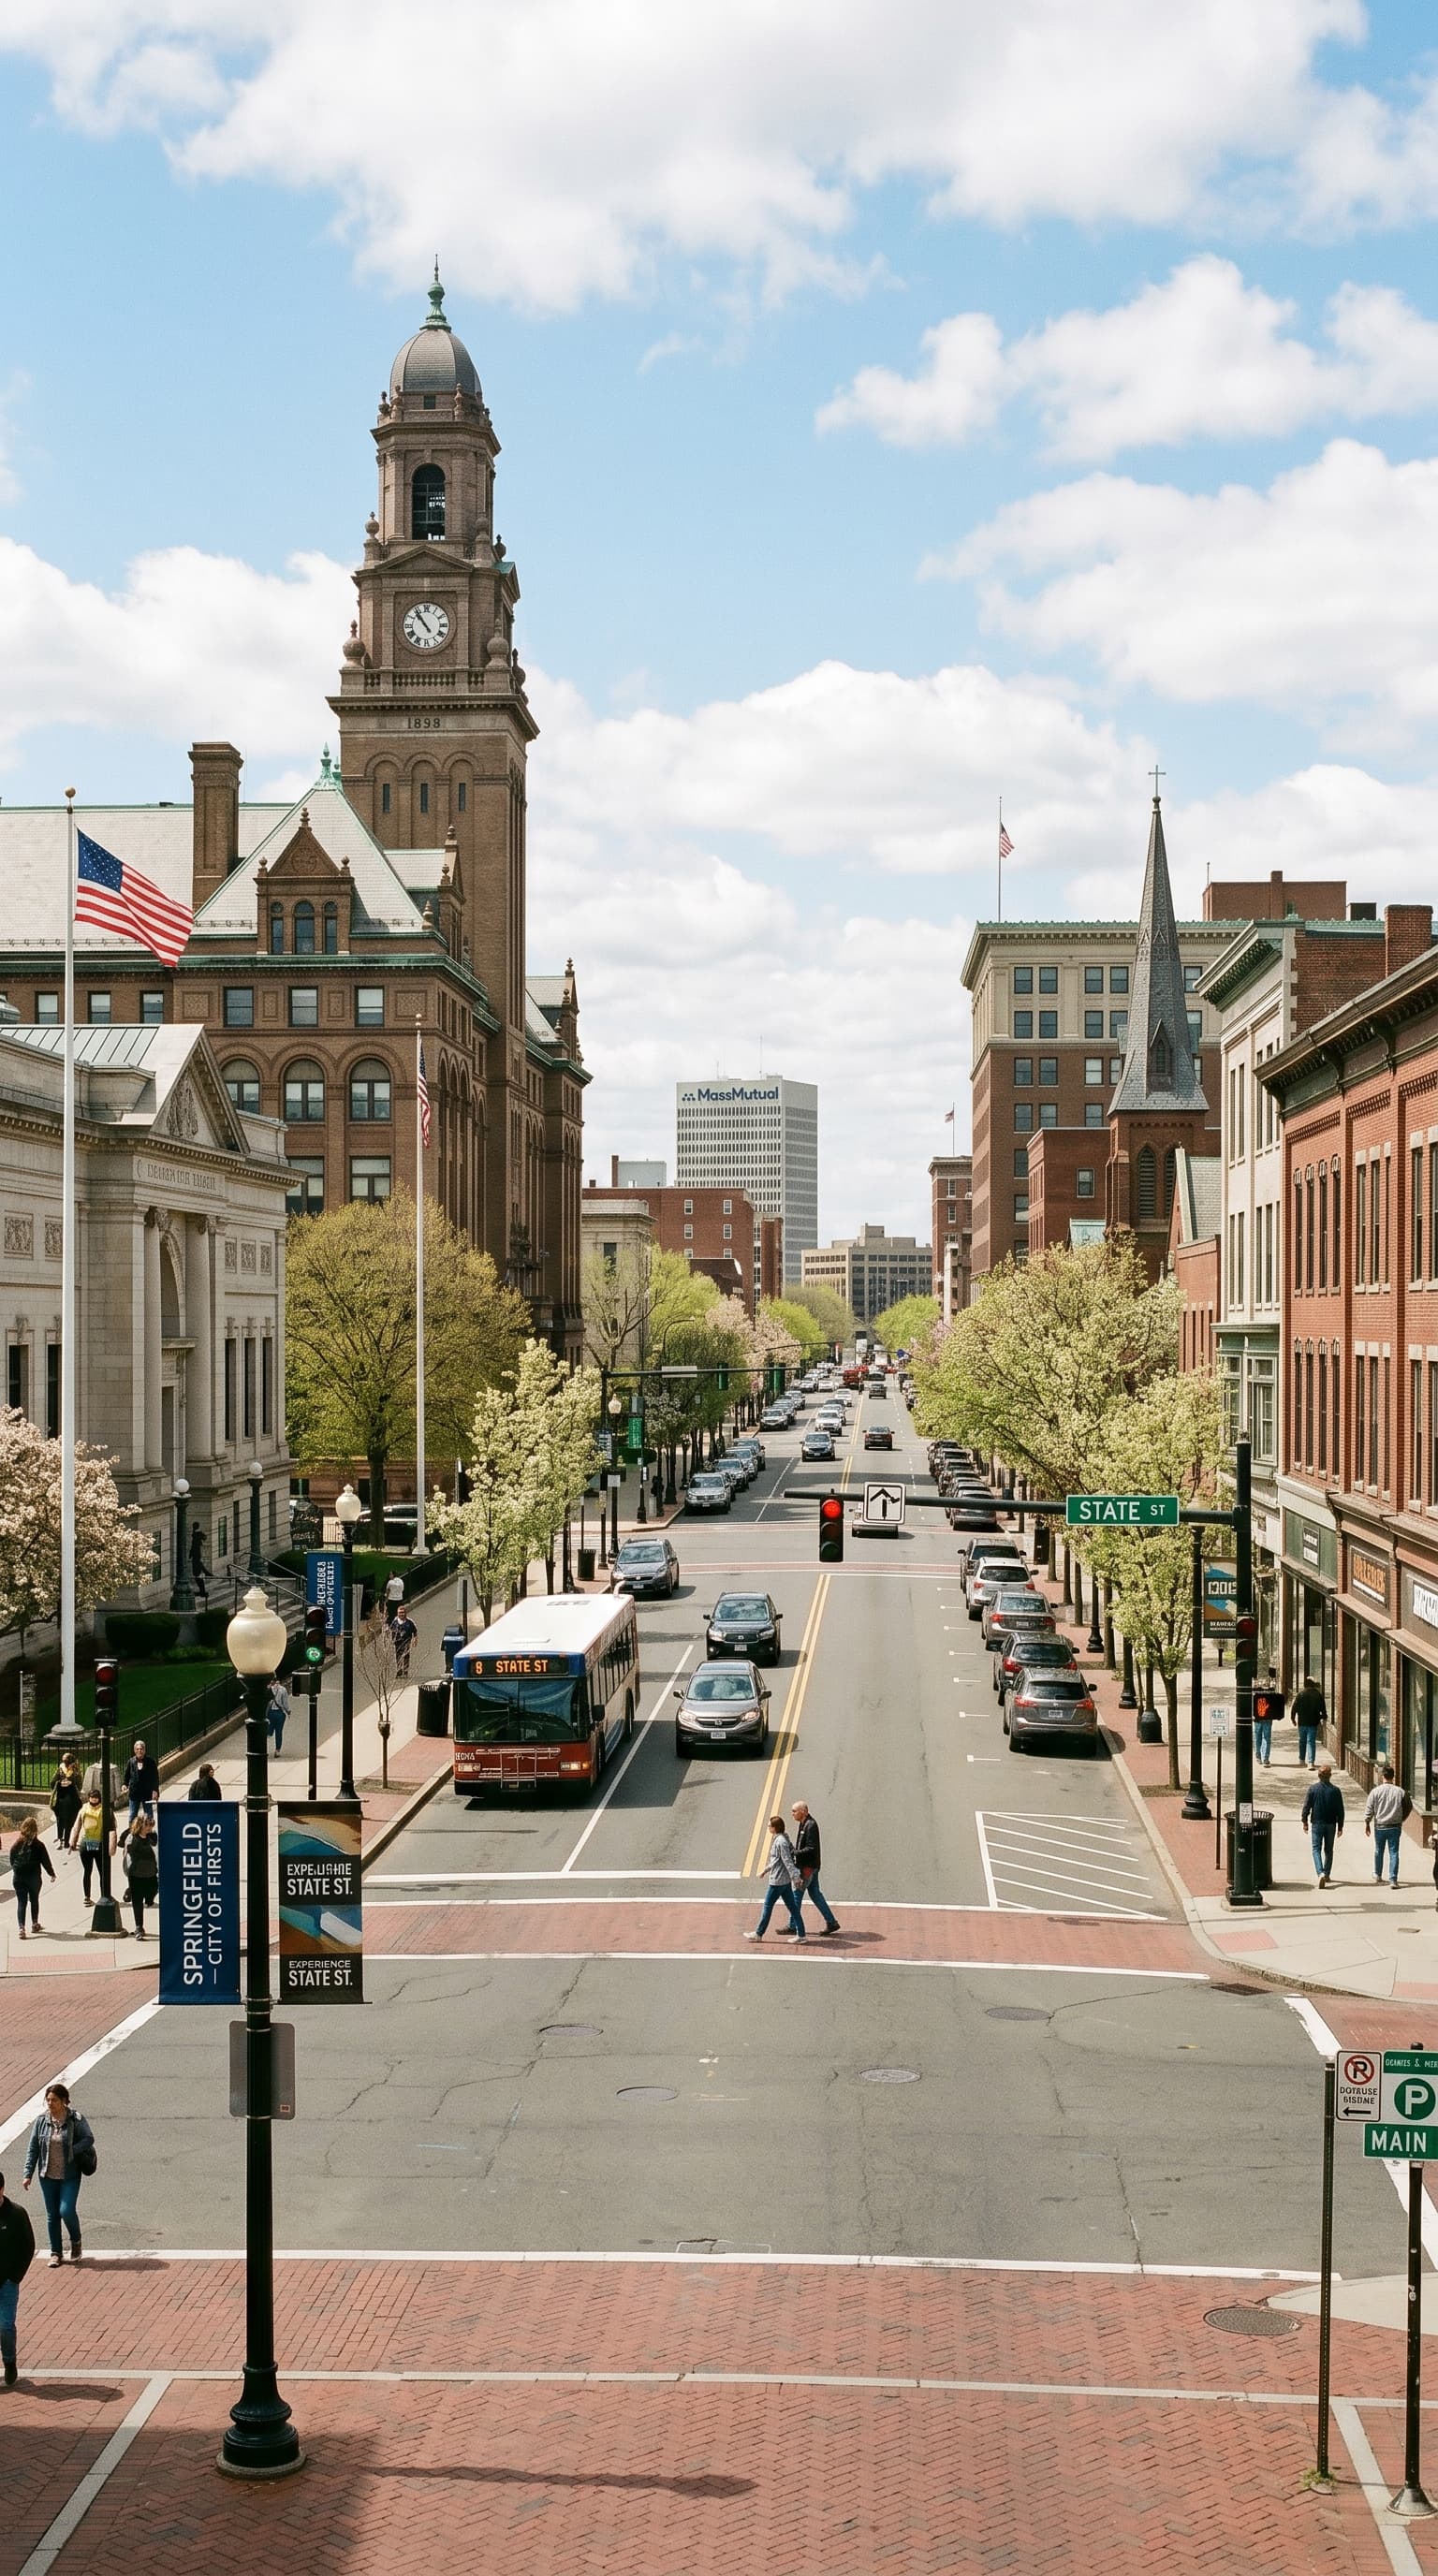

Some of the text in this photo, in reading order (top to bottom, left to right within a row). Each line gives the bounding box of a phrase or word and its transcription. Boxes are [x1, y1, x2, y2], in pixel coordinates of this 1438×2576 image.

[407, 717, 441, 729] 1898
[697, 1086, 779, 1102] MassMutual
[1079, 1500, 1166, 1521] STATE ST
[495, 1660, 531, 1674] STATE
[534, 1660, 549, 1673] ST
[207, 1823, 223, 1965] CITY OF FIRSTS
[286, 1877, 353, 1895] STATE ST.
[183, 1822, 203, 1985] SPRINGFIELD
[288, 1960, 351, 1969] EXPERIENCE
[288, 1969, 353, 1986] STATE ST.
[1404, 2085, 1429, 2115] P
[1372, 2130, 1427, 2153] MAIN
